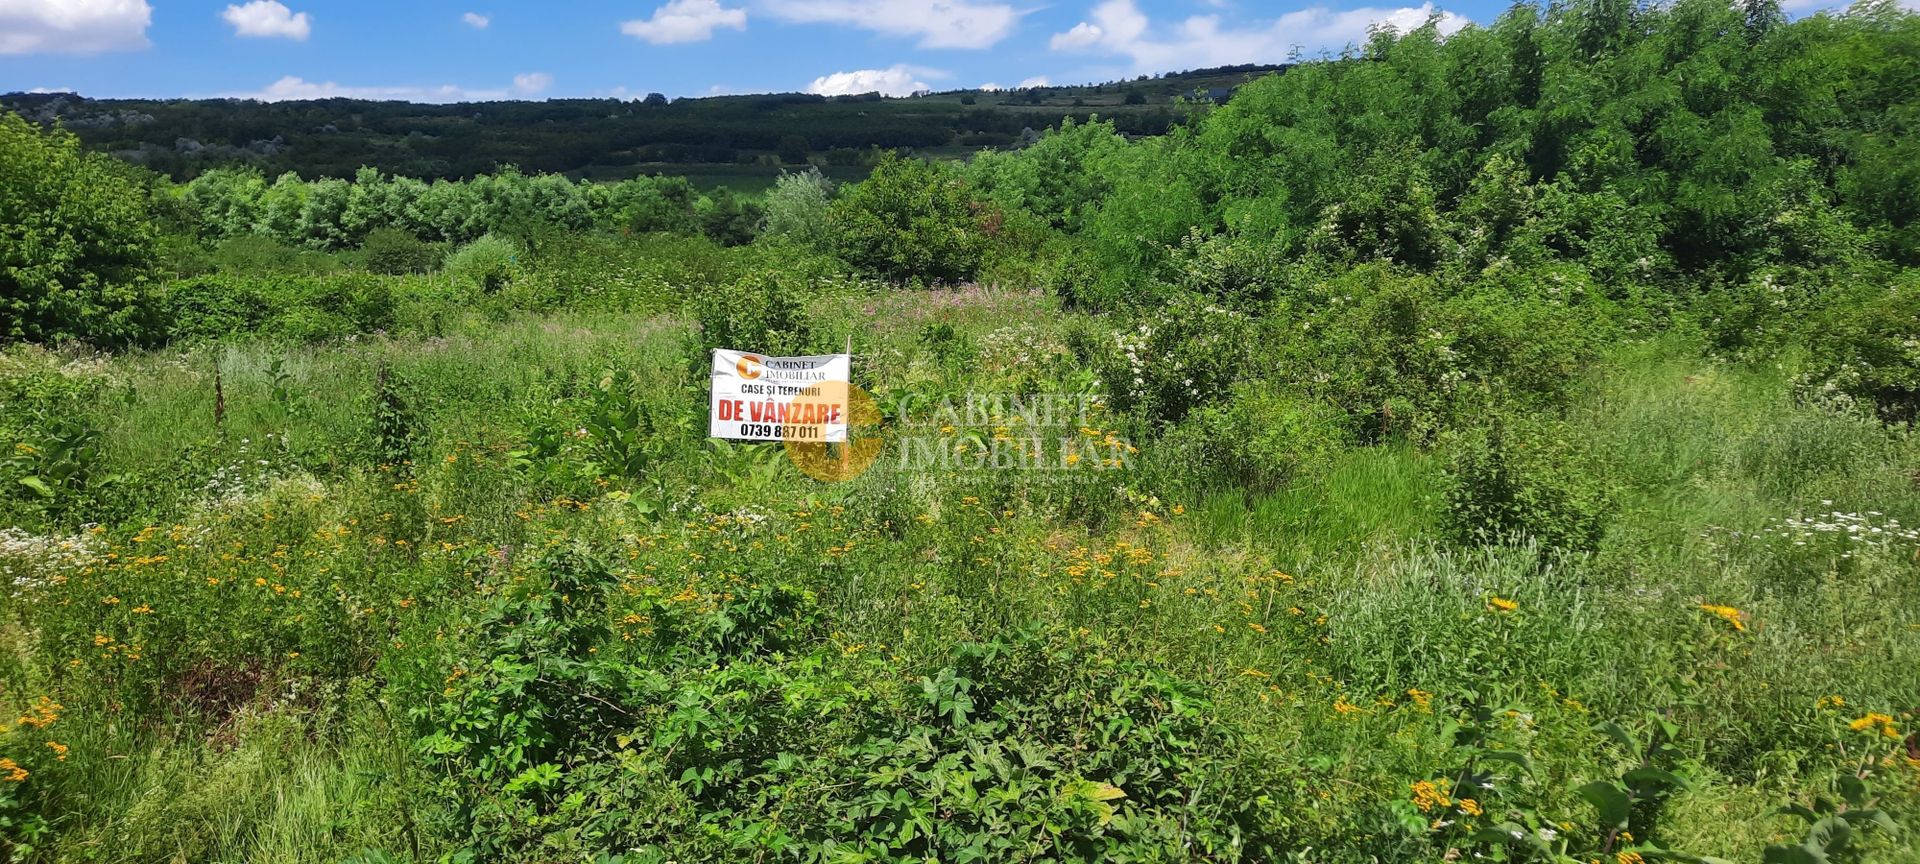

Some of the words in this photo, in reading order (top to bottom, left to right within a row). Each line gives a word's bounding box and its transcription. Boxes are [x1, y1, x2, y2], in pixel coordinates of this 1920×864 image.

[765, 360, 817, 369] CABINET
[765, 370, 826, 380] IMOBILIAR
[741, 383, 764, 395] CASE
[778, 385, 821, 397] TERENURI
[718, 399, 744, 421] DE
[750, 397, 841, 424] VÂNZARE
[740, 423, 771, 438] 0739
[774, 425, 796, 438] 887
[799, 426, 818, 438] 011
